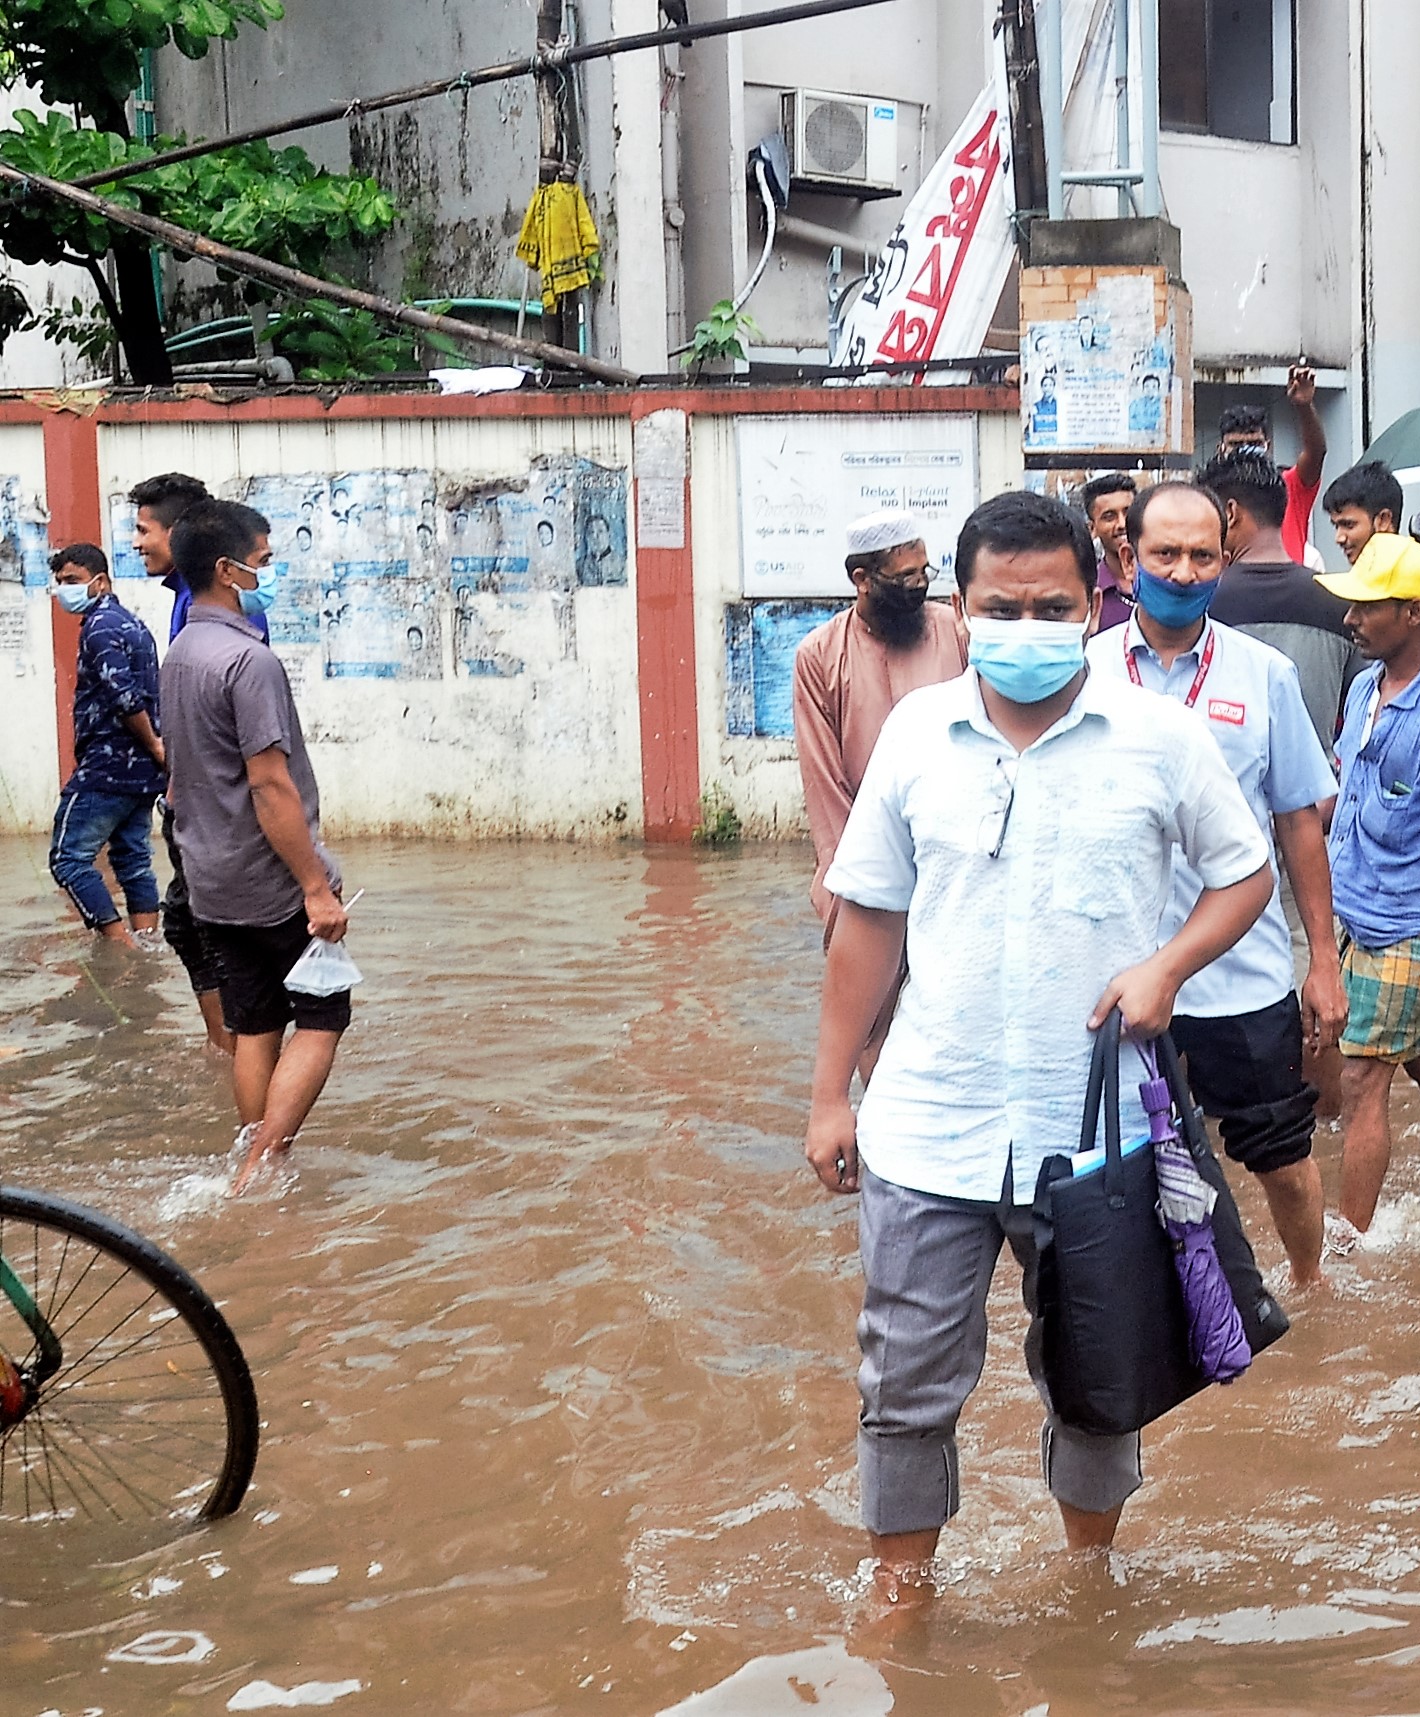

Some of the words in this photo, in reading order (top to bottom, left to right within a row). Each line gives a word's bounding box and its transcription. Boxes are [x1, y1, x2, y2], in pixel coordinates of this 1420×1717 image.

[861, 485, 898, 498] Relax
[881, 498, 899, 508] IUD
[908, 498, 948, 510] Implant
